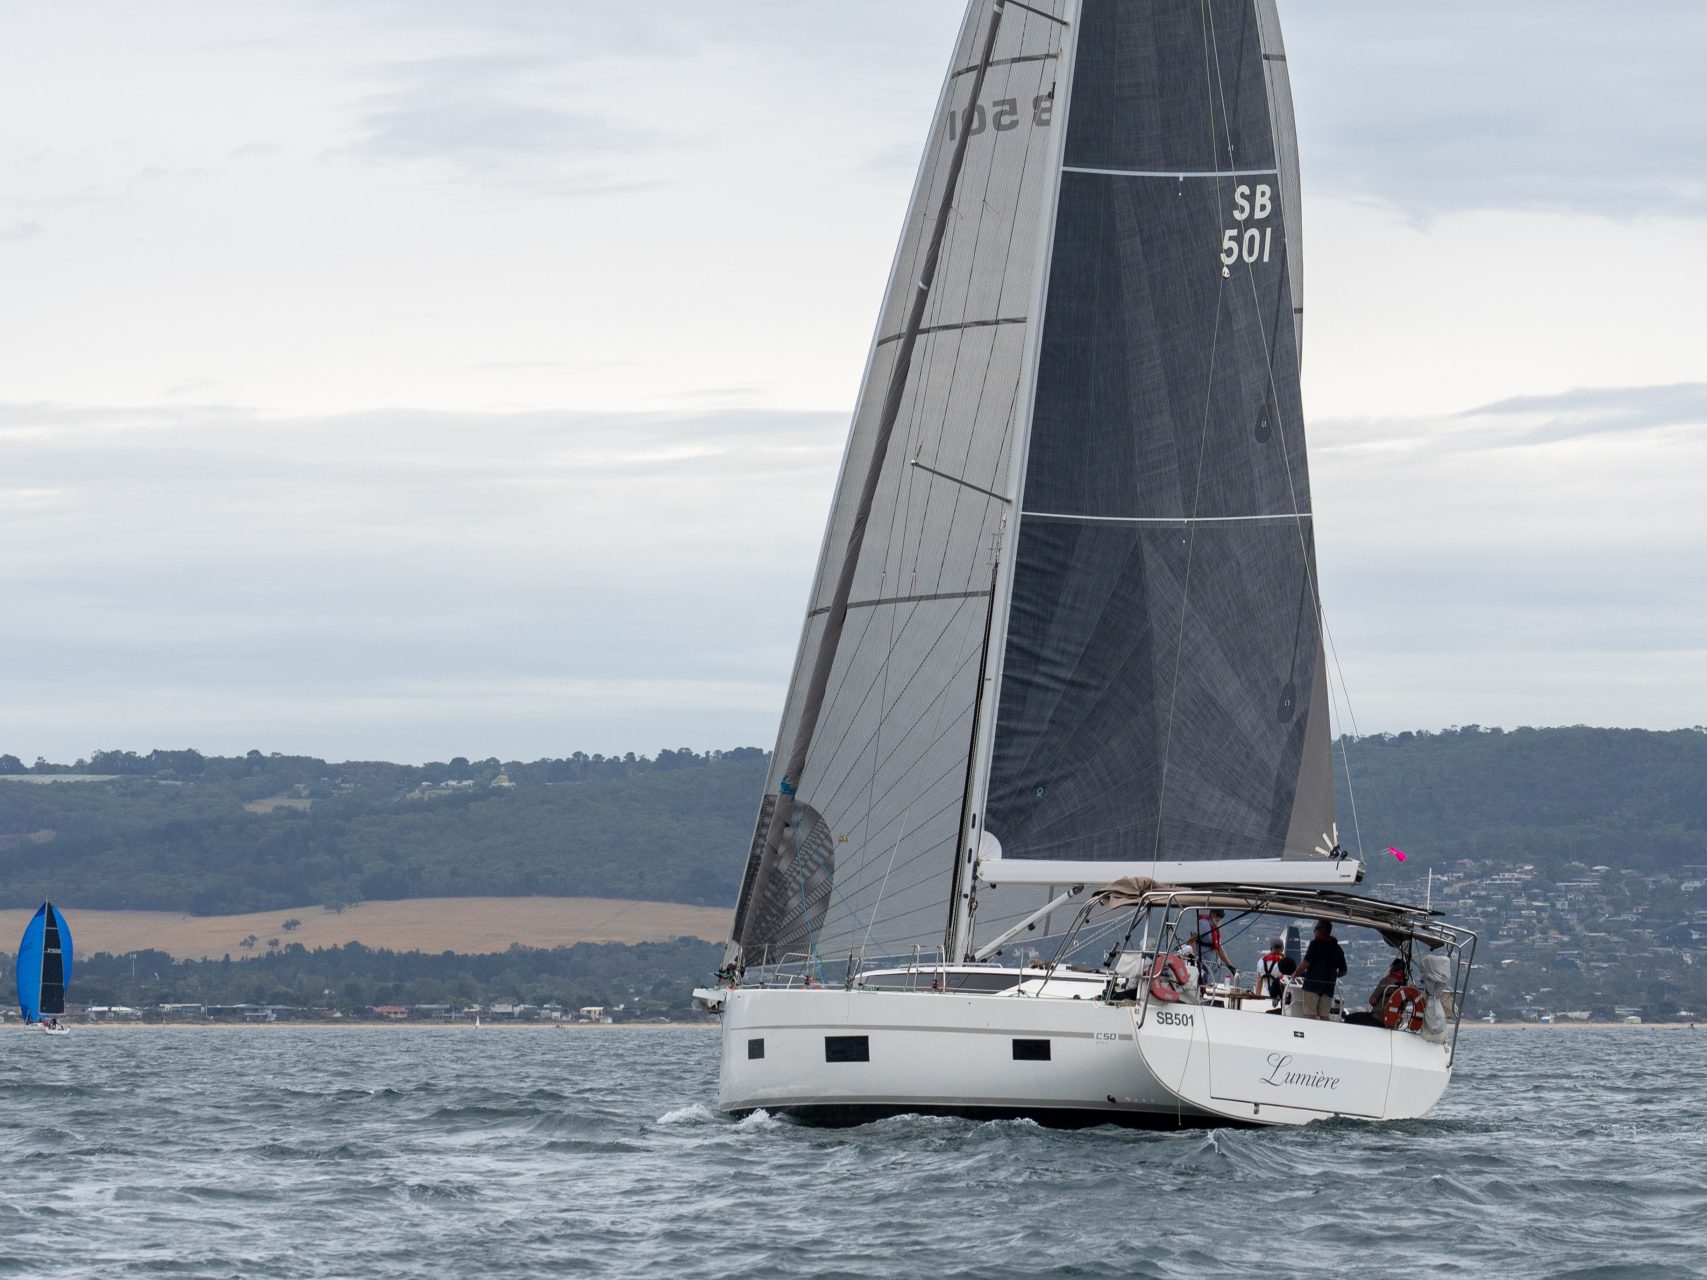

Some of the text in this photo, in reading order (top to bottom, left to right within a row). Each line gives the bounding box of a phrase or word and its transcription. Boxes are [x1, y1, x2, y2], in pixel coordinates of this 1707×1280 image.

[1232, 184, 1272, 221] SB
[1220, 227, 1272, 265] 501
[1156, 1011, 1194, 1027] SB501
[1259, 1052, 1340, 1090] Lumière
